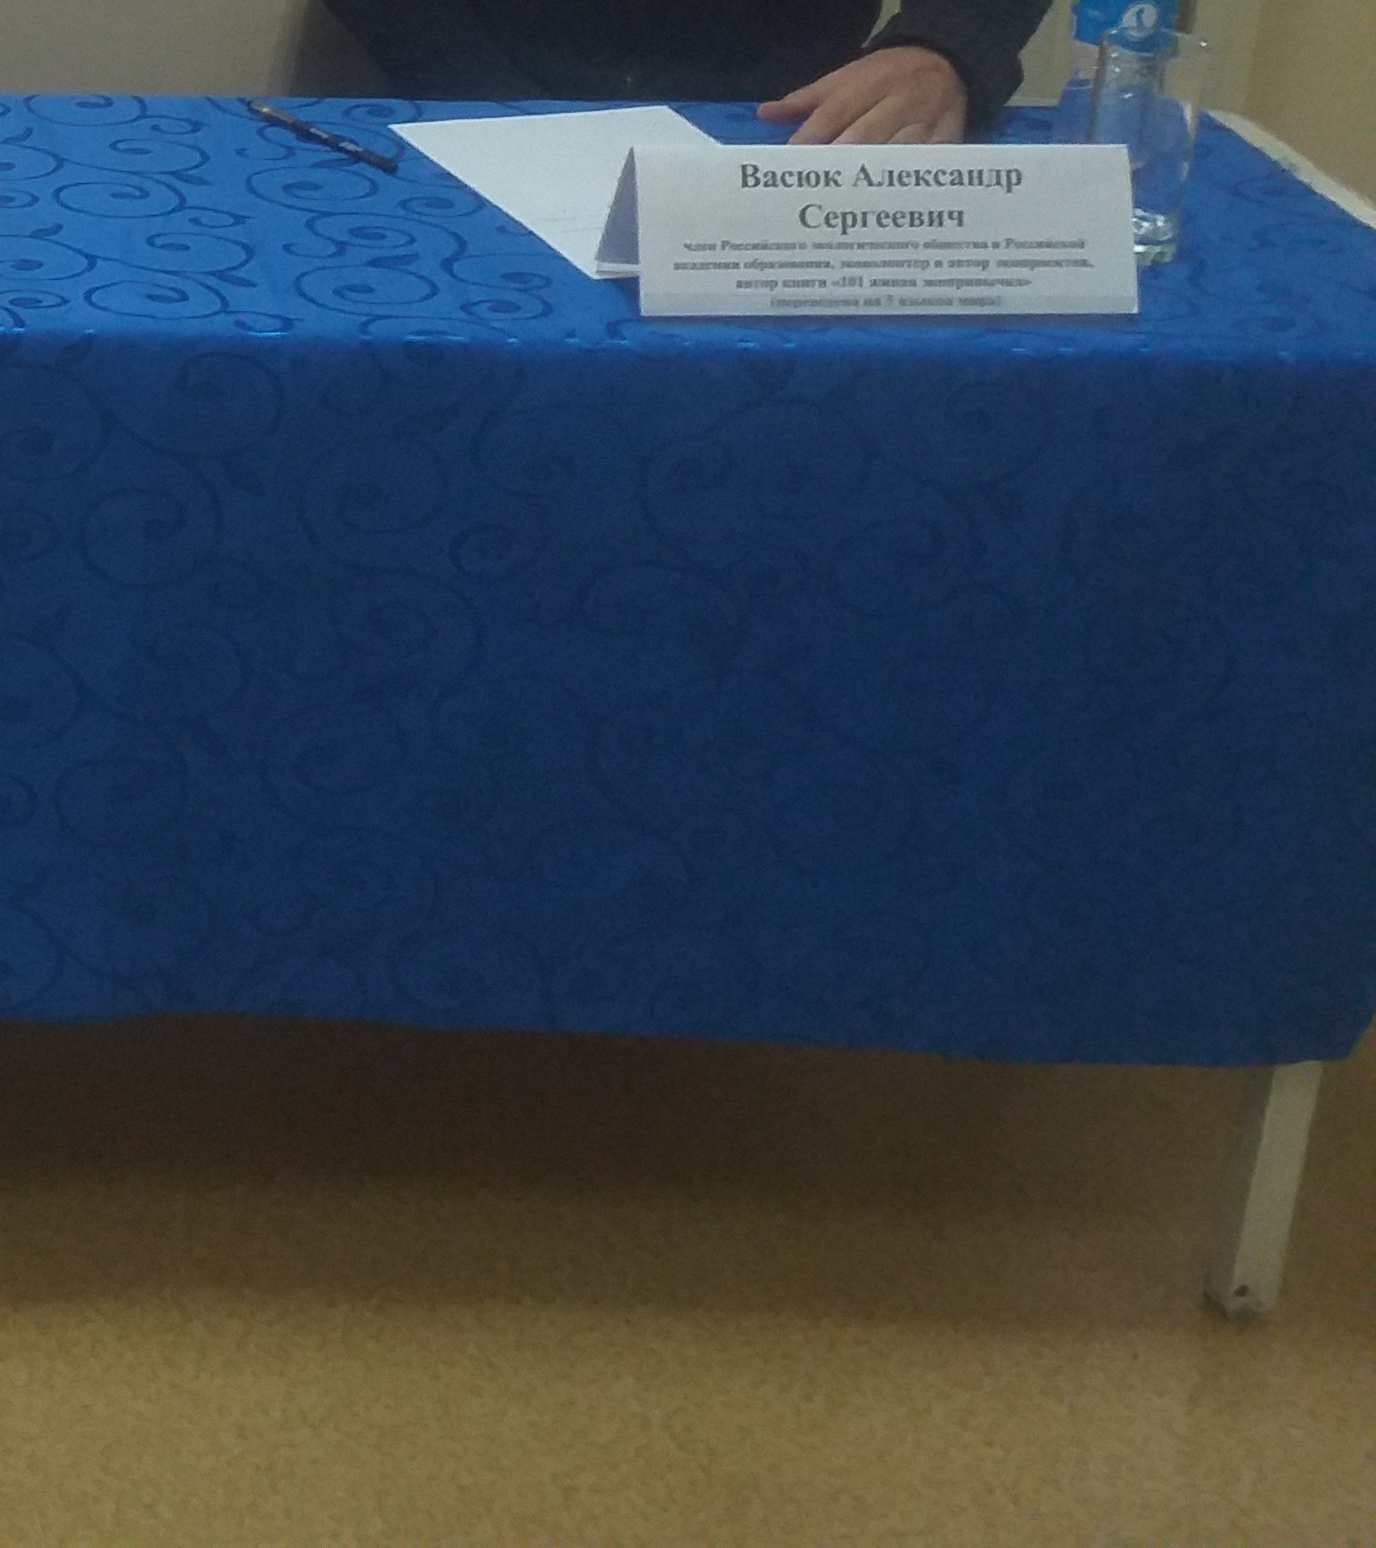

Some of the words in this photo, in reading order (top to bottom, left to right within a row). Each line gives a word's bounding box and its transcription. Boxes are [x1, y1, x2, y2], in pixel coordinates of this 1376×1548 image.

[739, 162, 843, 189] Васюк
[852, 162, 1023, 193] Александр
[798, 203, 966, 235] Сергеевич
